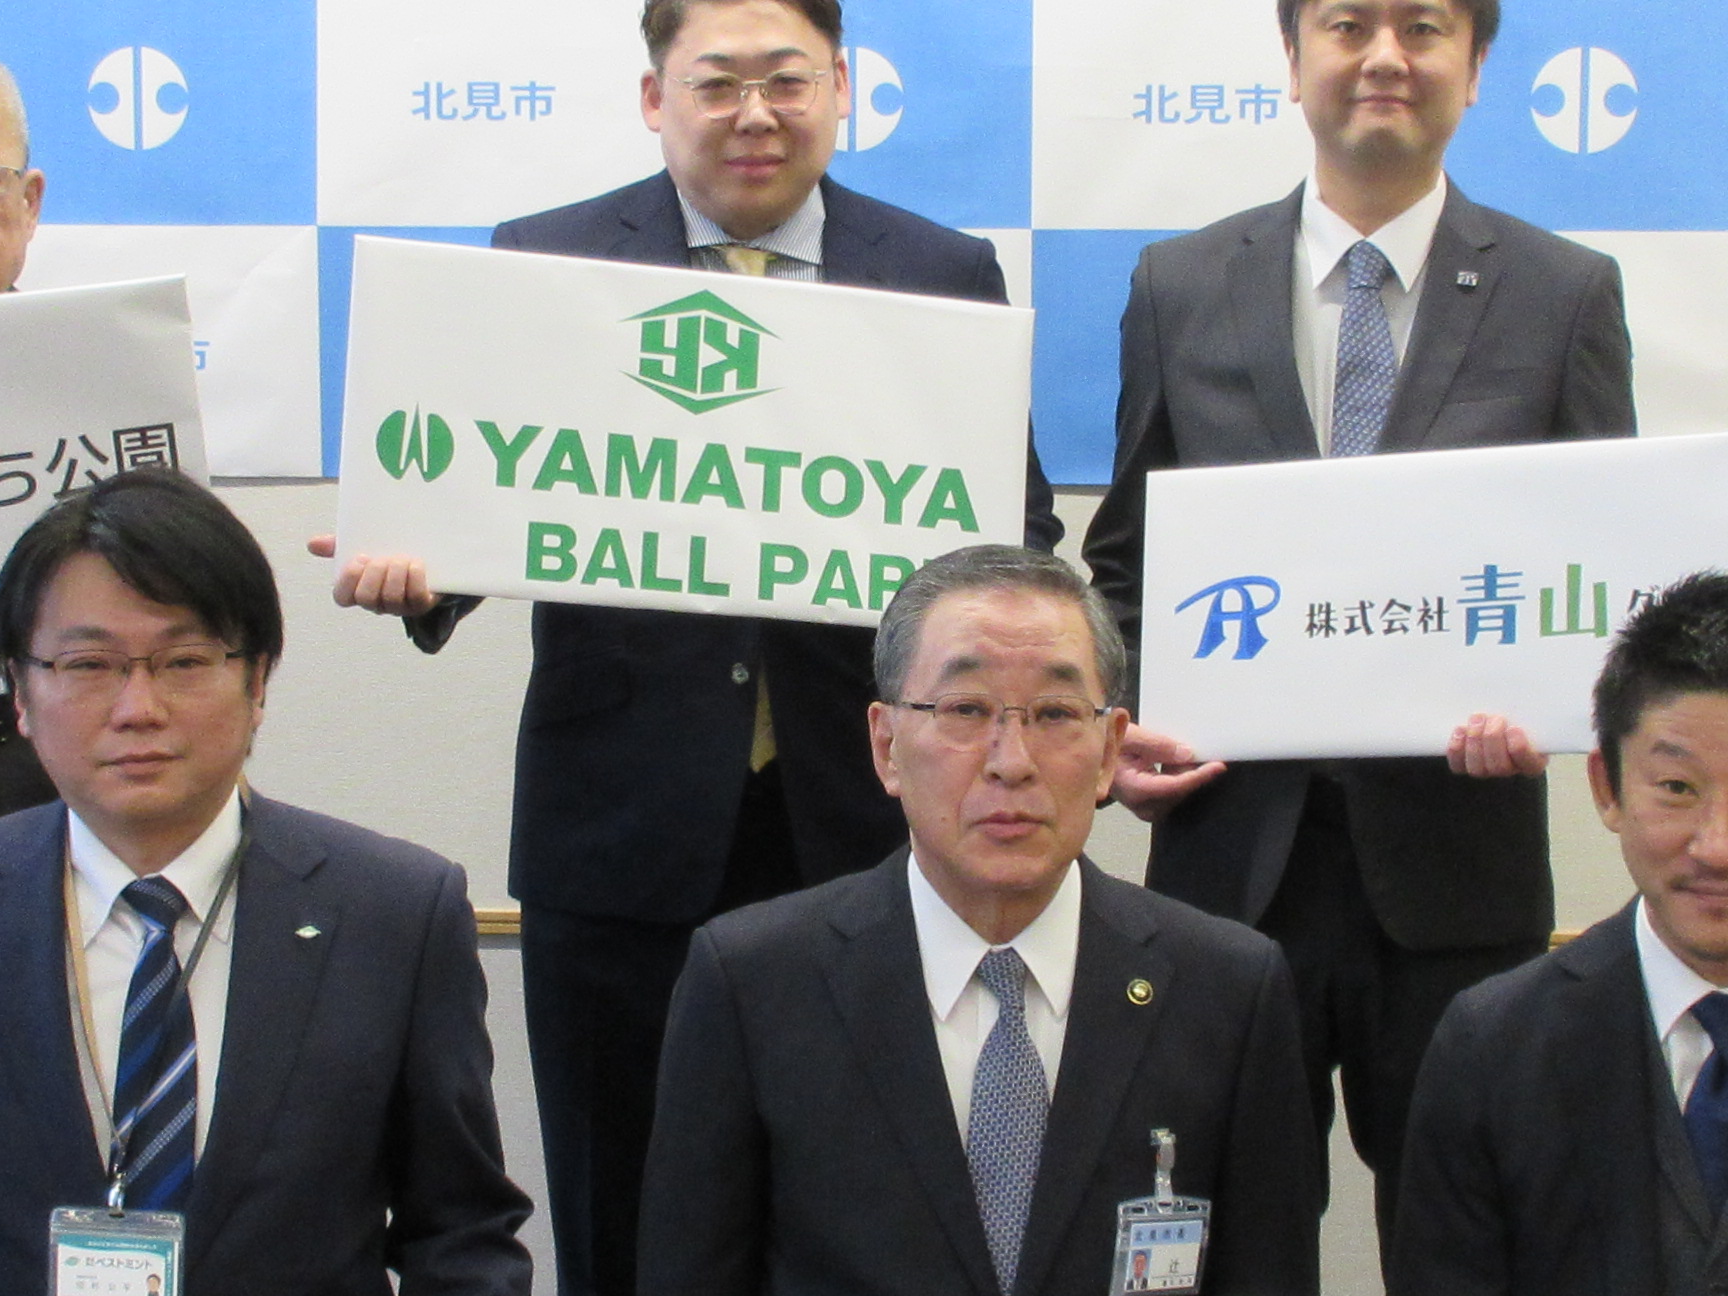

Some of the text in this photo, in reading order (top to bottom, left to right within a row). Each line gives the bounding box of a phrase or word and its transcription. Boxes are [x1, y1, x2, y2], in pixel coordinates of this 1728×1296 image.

[410, 80, 557, 122] 北見市
[1131, 82, 1283, 126] 北見市
[474, 419, 981, 534] YAMATOYA
[525, 520, 934, 611] BALL PAR
